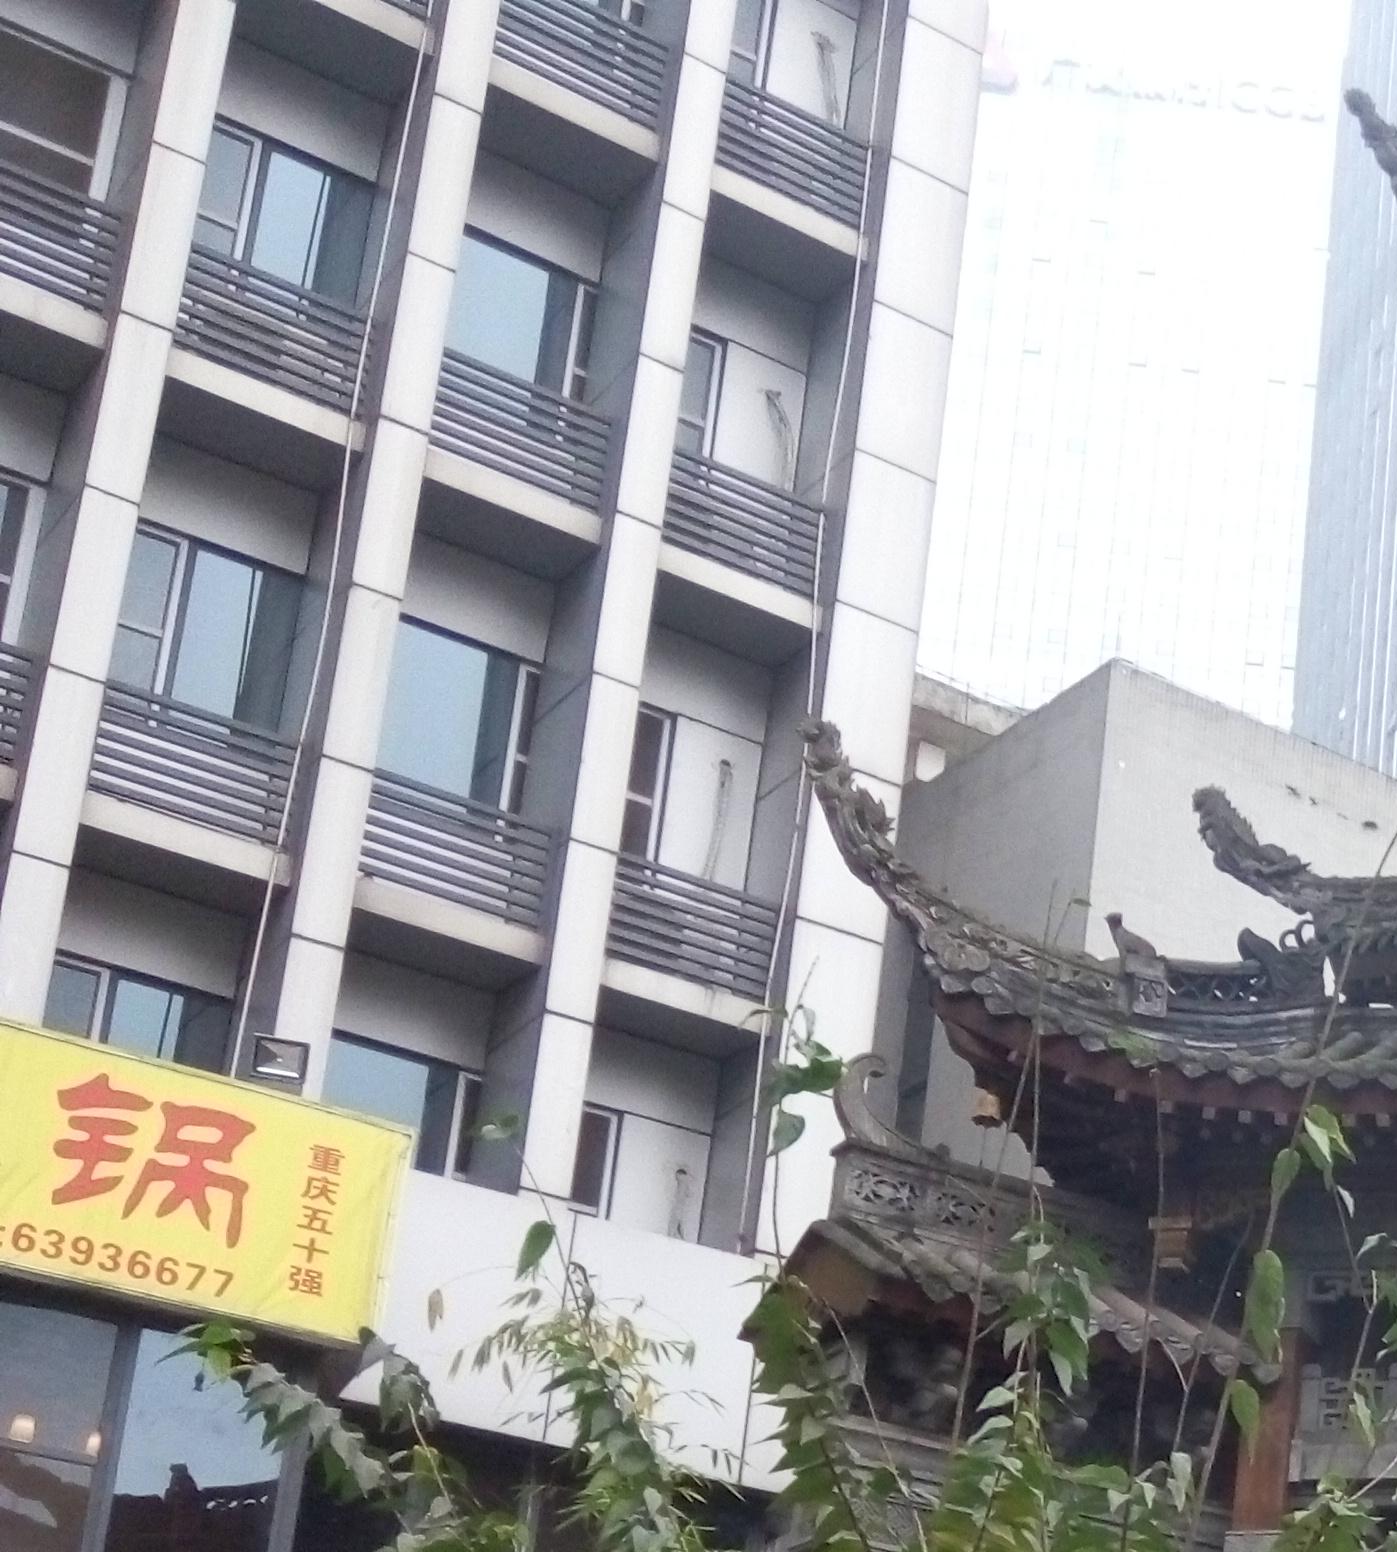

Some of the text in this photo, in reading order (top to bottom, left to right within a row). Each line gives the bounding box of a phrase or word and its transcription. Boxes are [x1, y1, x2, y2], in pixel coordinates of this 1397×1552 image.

[51, 1072, 257, 1250] 锅
[287, 1143, 346, 1298] 重庆五十强
